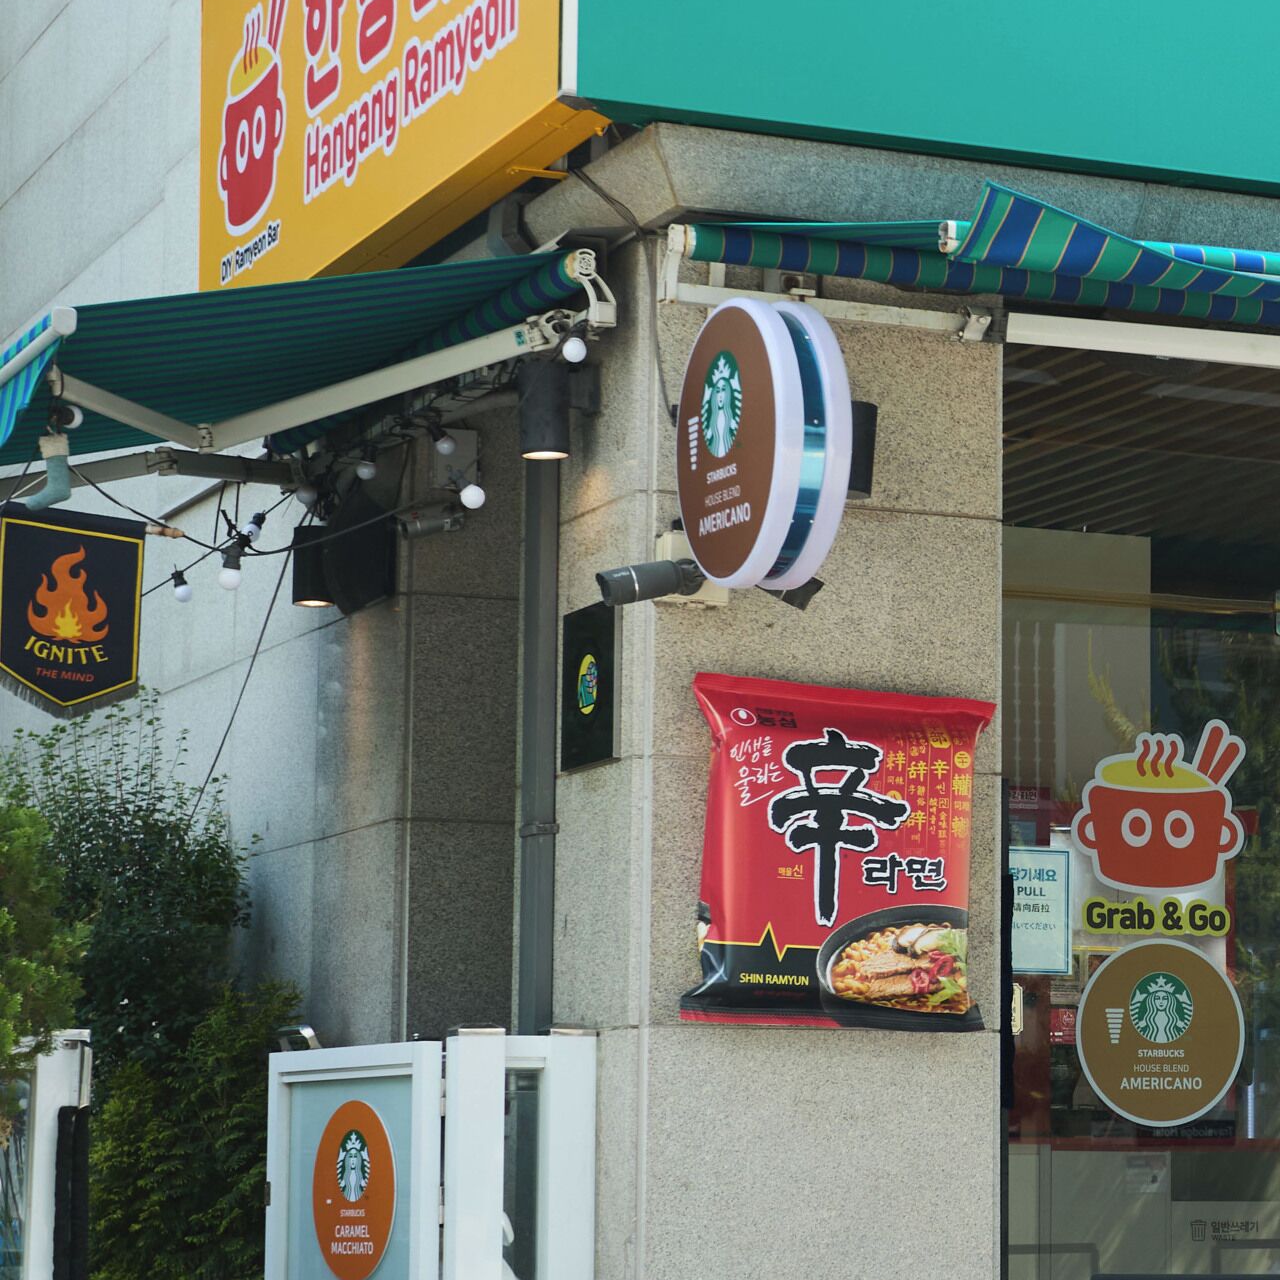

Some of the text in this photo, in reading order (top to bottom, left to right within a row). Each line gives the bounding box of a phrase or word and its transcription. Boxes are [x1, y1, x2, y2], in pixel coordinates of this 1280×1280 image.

[306, 77, 396, 199] Hangang
[221, 223, 280, 282] DIY Ramyeon Bar
[706, 463, 737, 485] STARBUCKS
[704, 485, 741, 508] HOUSE BLEND
[699, 502, 751, 537] AMERICANO
[24, 635, 108, 665] IGNITE
[36, 667, 94, 682] THE MIND
[729, 735, 774, 763] 인생을
[733, 762, 785, 808] 울리는
[768, 727, 911, 927] 辛
[861, 852, 948, 893] 라면
[1017, 886, 1046, 897] PULL
[1086, 902, 1226, 931] Grab & Go
[739, 972, 809, 985] SHIN RAMYUN
[1137, 1049, 1185, 1058] STARBUCKS
[1133, 1064, 1190, 1073] HOUSE BLEND
[1120, 1077, 1203, 1091] AMERICANO
[340, 1209, 366, 1217] STARBUCKS
[335, 1224, 370, 1238] CARAMEL
[1210, 1220, 1259, 1234] 일반쓰레기
[331, 1241, 374, 1255] MACCHIATO
